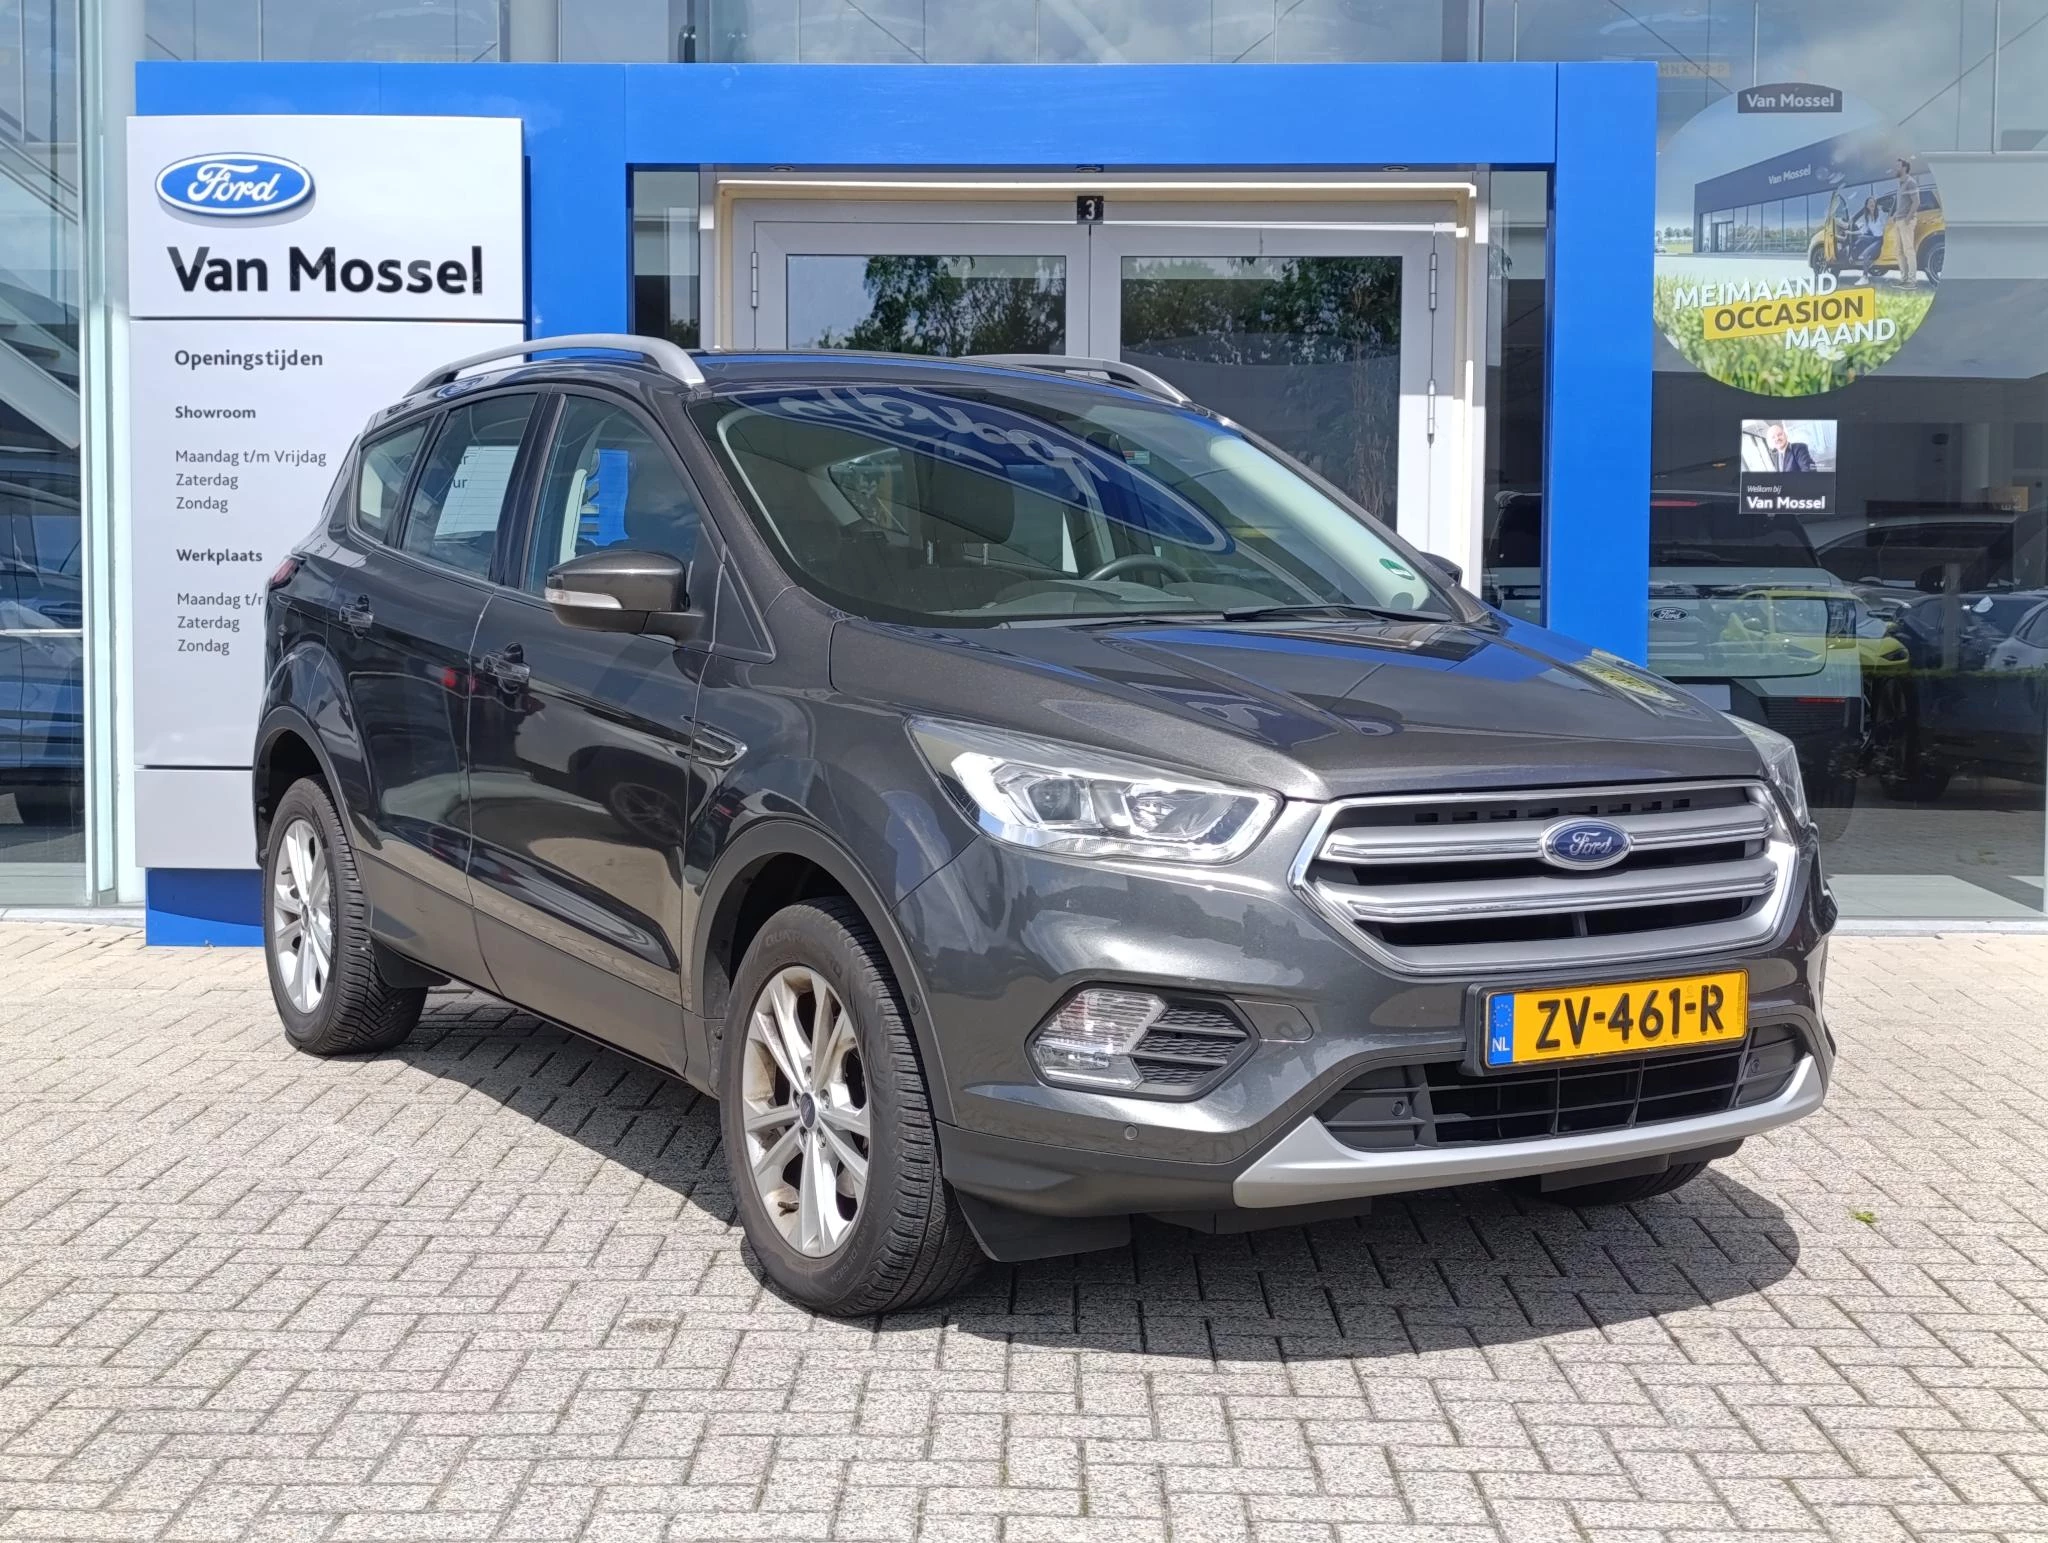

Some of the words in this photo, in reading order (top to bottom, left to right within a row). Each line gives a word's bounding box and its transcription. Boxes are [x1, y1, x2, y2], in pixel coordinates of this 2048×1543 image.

[1746, 93, 1776, 107] Van
[1780, 92, 1834, 107] Mossel
[187, 163, 281, 203] Ford
[1768, 175, 1782, 185] Van
[1783, 164, 1812, 181] Mossel
[1086, 200, 1095, 220] 3
[167, 246, 268, 292] Van
[289, 245, 483, 295] Mossel
[1674, 273, 1838, 310] MEIMAAND
[1714, 296, 1863, 331] OCCASION
[1785, 319, 1896, 349] MAAND
[174, 350, 324, 369] Openingstijden
[175, 406, 256, 420] Showroom
[175, 450, 240, 466] Maandag
[242, 450, 271, 464] t/m
[275, 450, 327, 466] Vrijdag
[175, 473, 239, 490] Zaterdag
[1747, 485, 1773, 493] Welkom
[176, 496, 228, 513] Zondag
[1747, 496, 1773, 509] Van
[1777, 495, 1826, 509] Mossel
[176, 549, 263, 565] Werkplaats
[177, 592, 241, 609] Maandag
[177, 616, 240, 632] Zaterdag
[178, 639, 230, 656] Zondag
[1569, 831, 1613, 856] Ford
[1492, 1038, 1510, 1052] NL
[1536, 985, 1724, 1053] ZV-461-R
